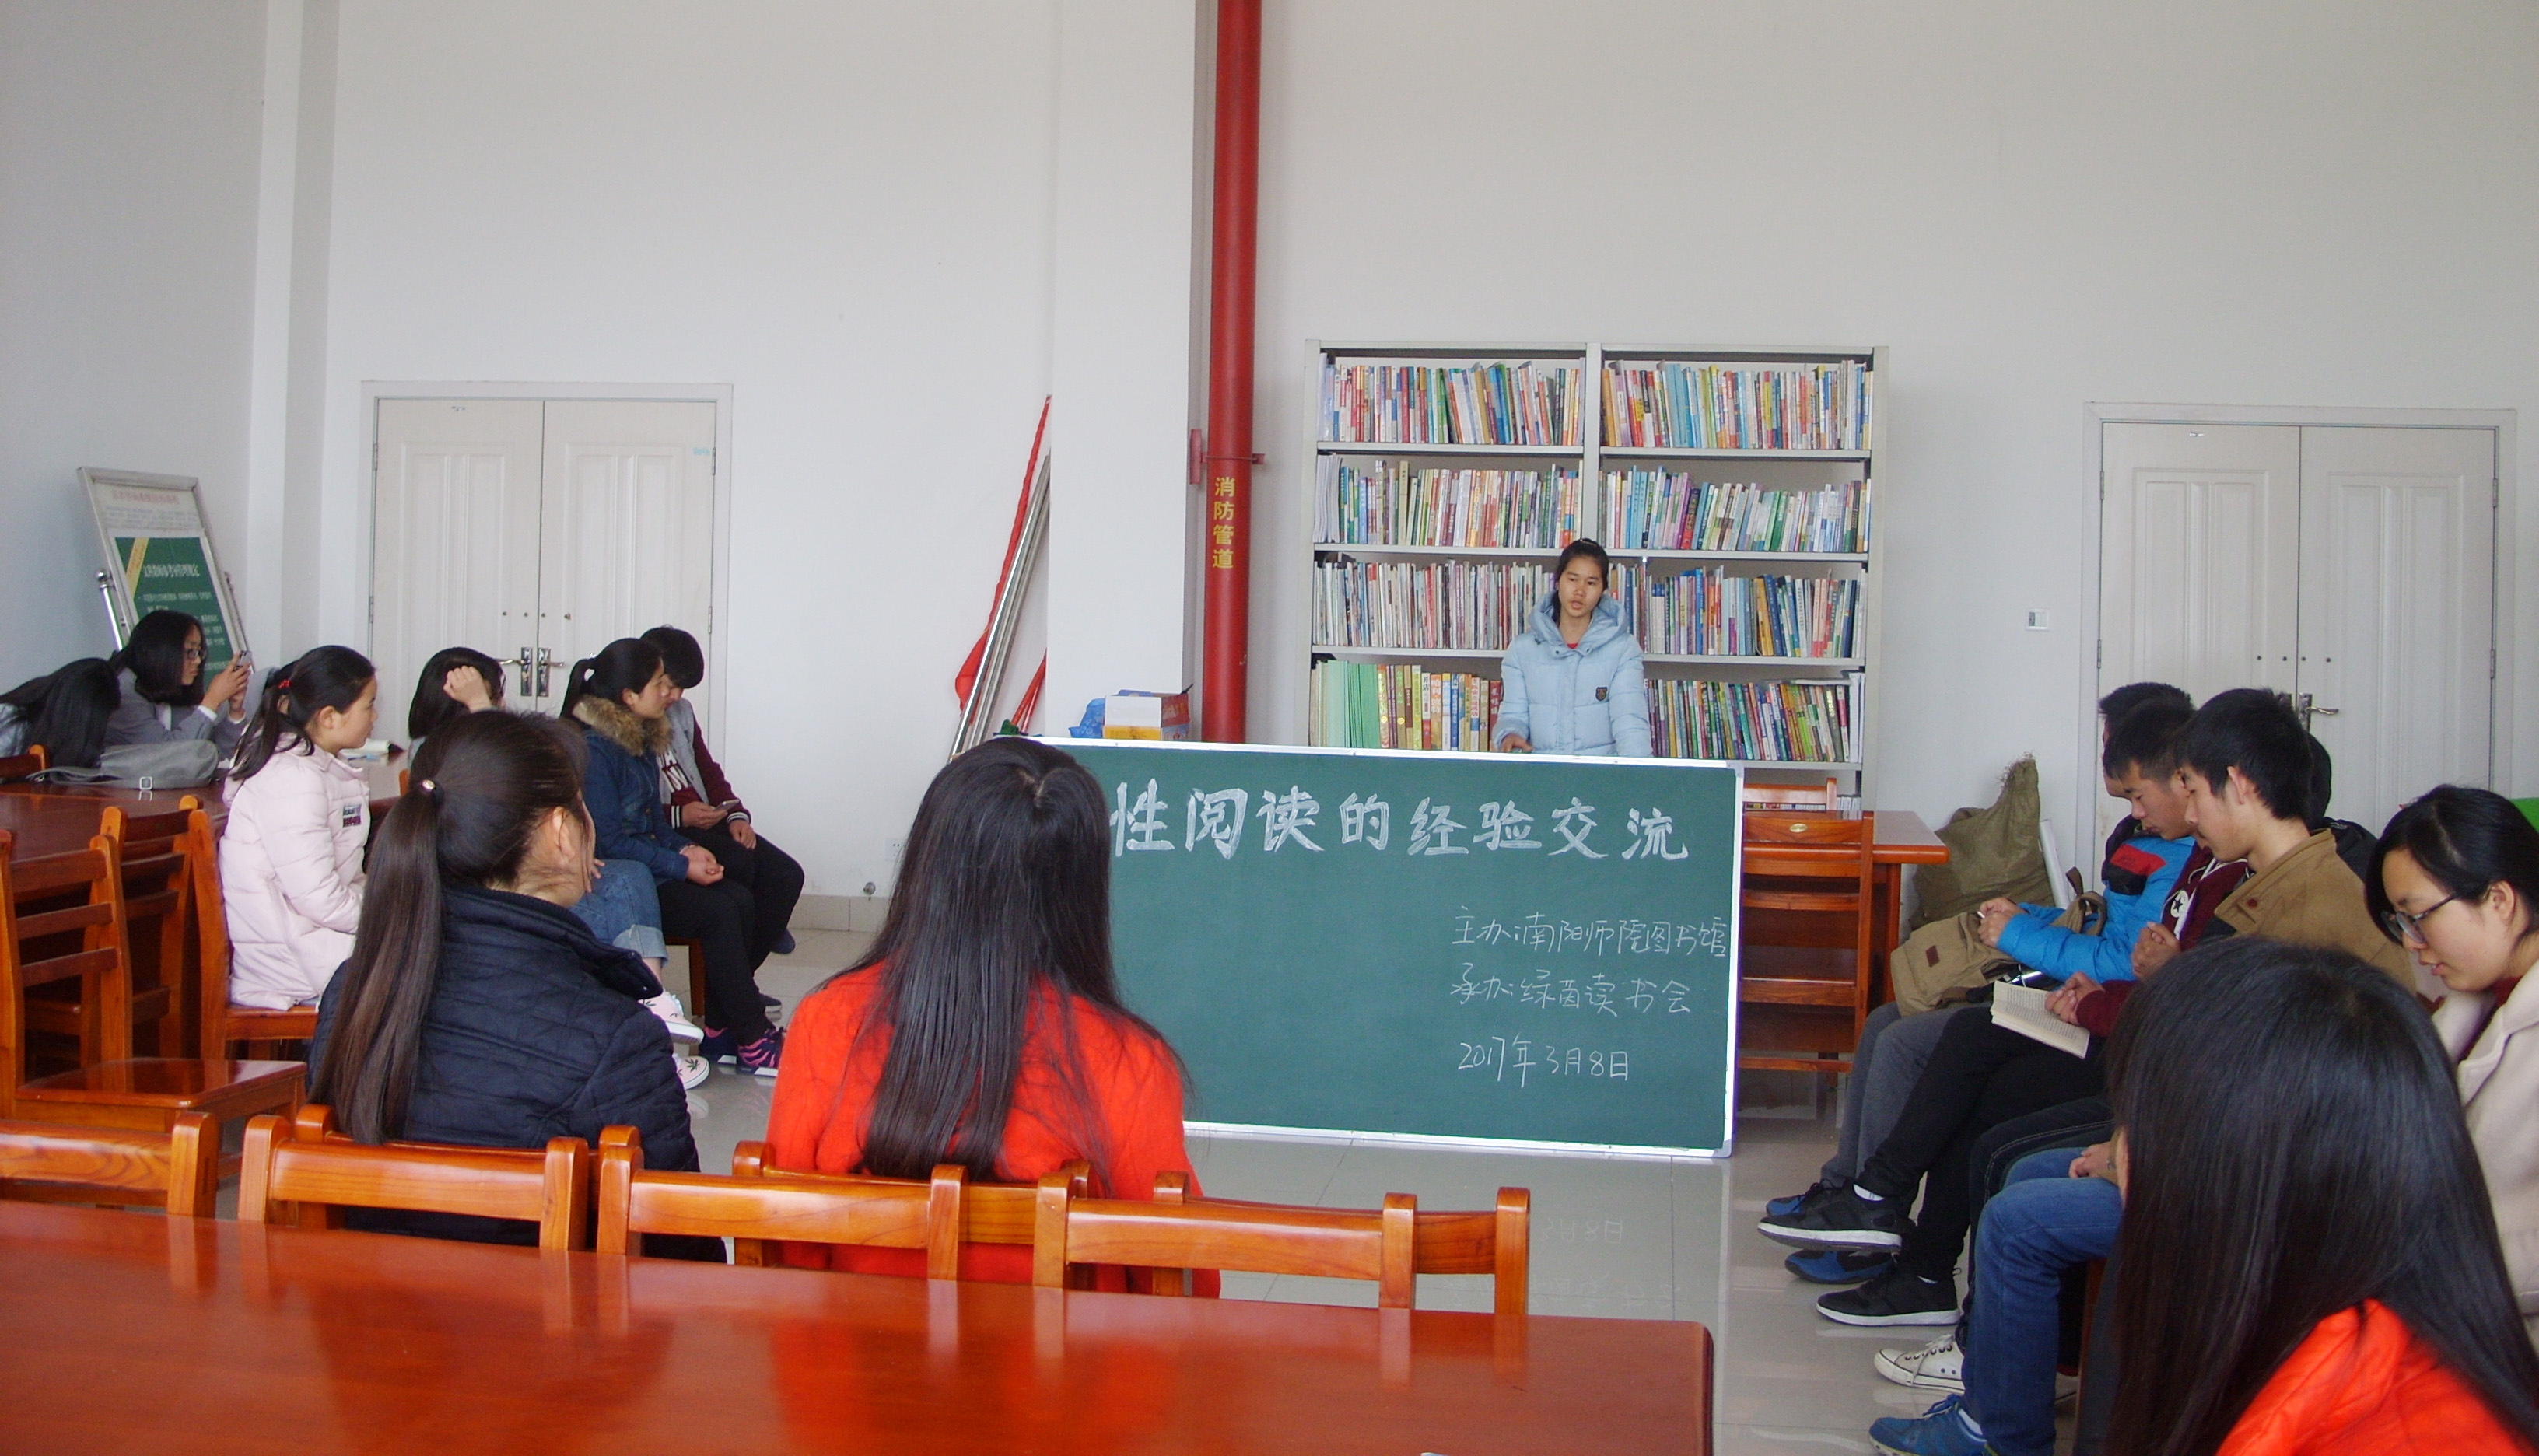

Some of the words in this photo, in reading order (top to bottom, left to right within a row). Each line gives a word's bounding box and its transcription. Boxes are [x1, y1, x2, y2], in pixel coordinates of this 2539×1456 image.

[1213, 476, 1236, 569] 消防管道
[1109, 778, 1690, 860] 性阅读的经验交流
[1458, 1034, 1629, 1088] 2017年3月8日
